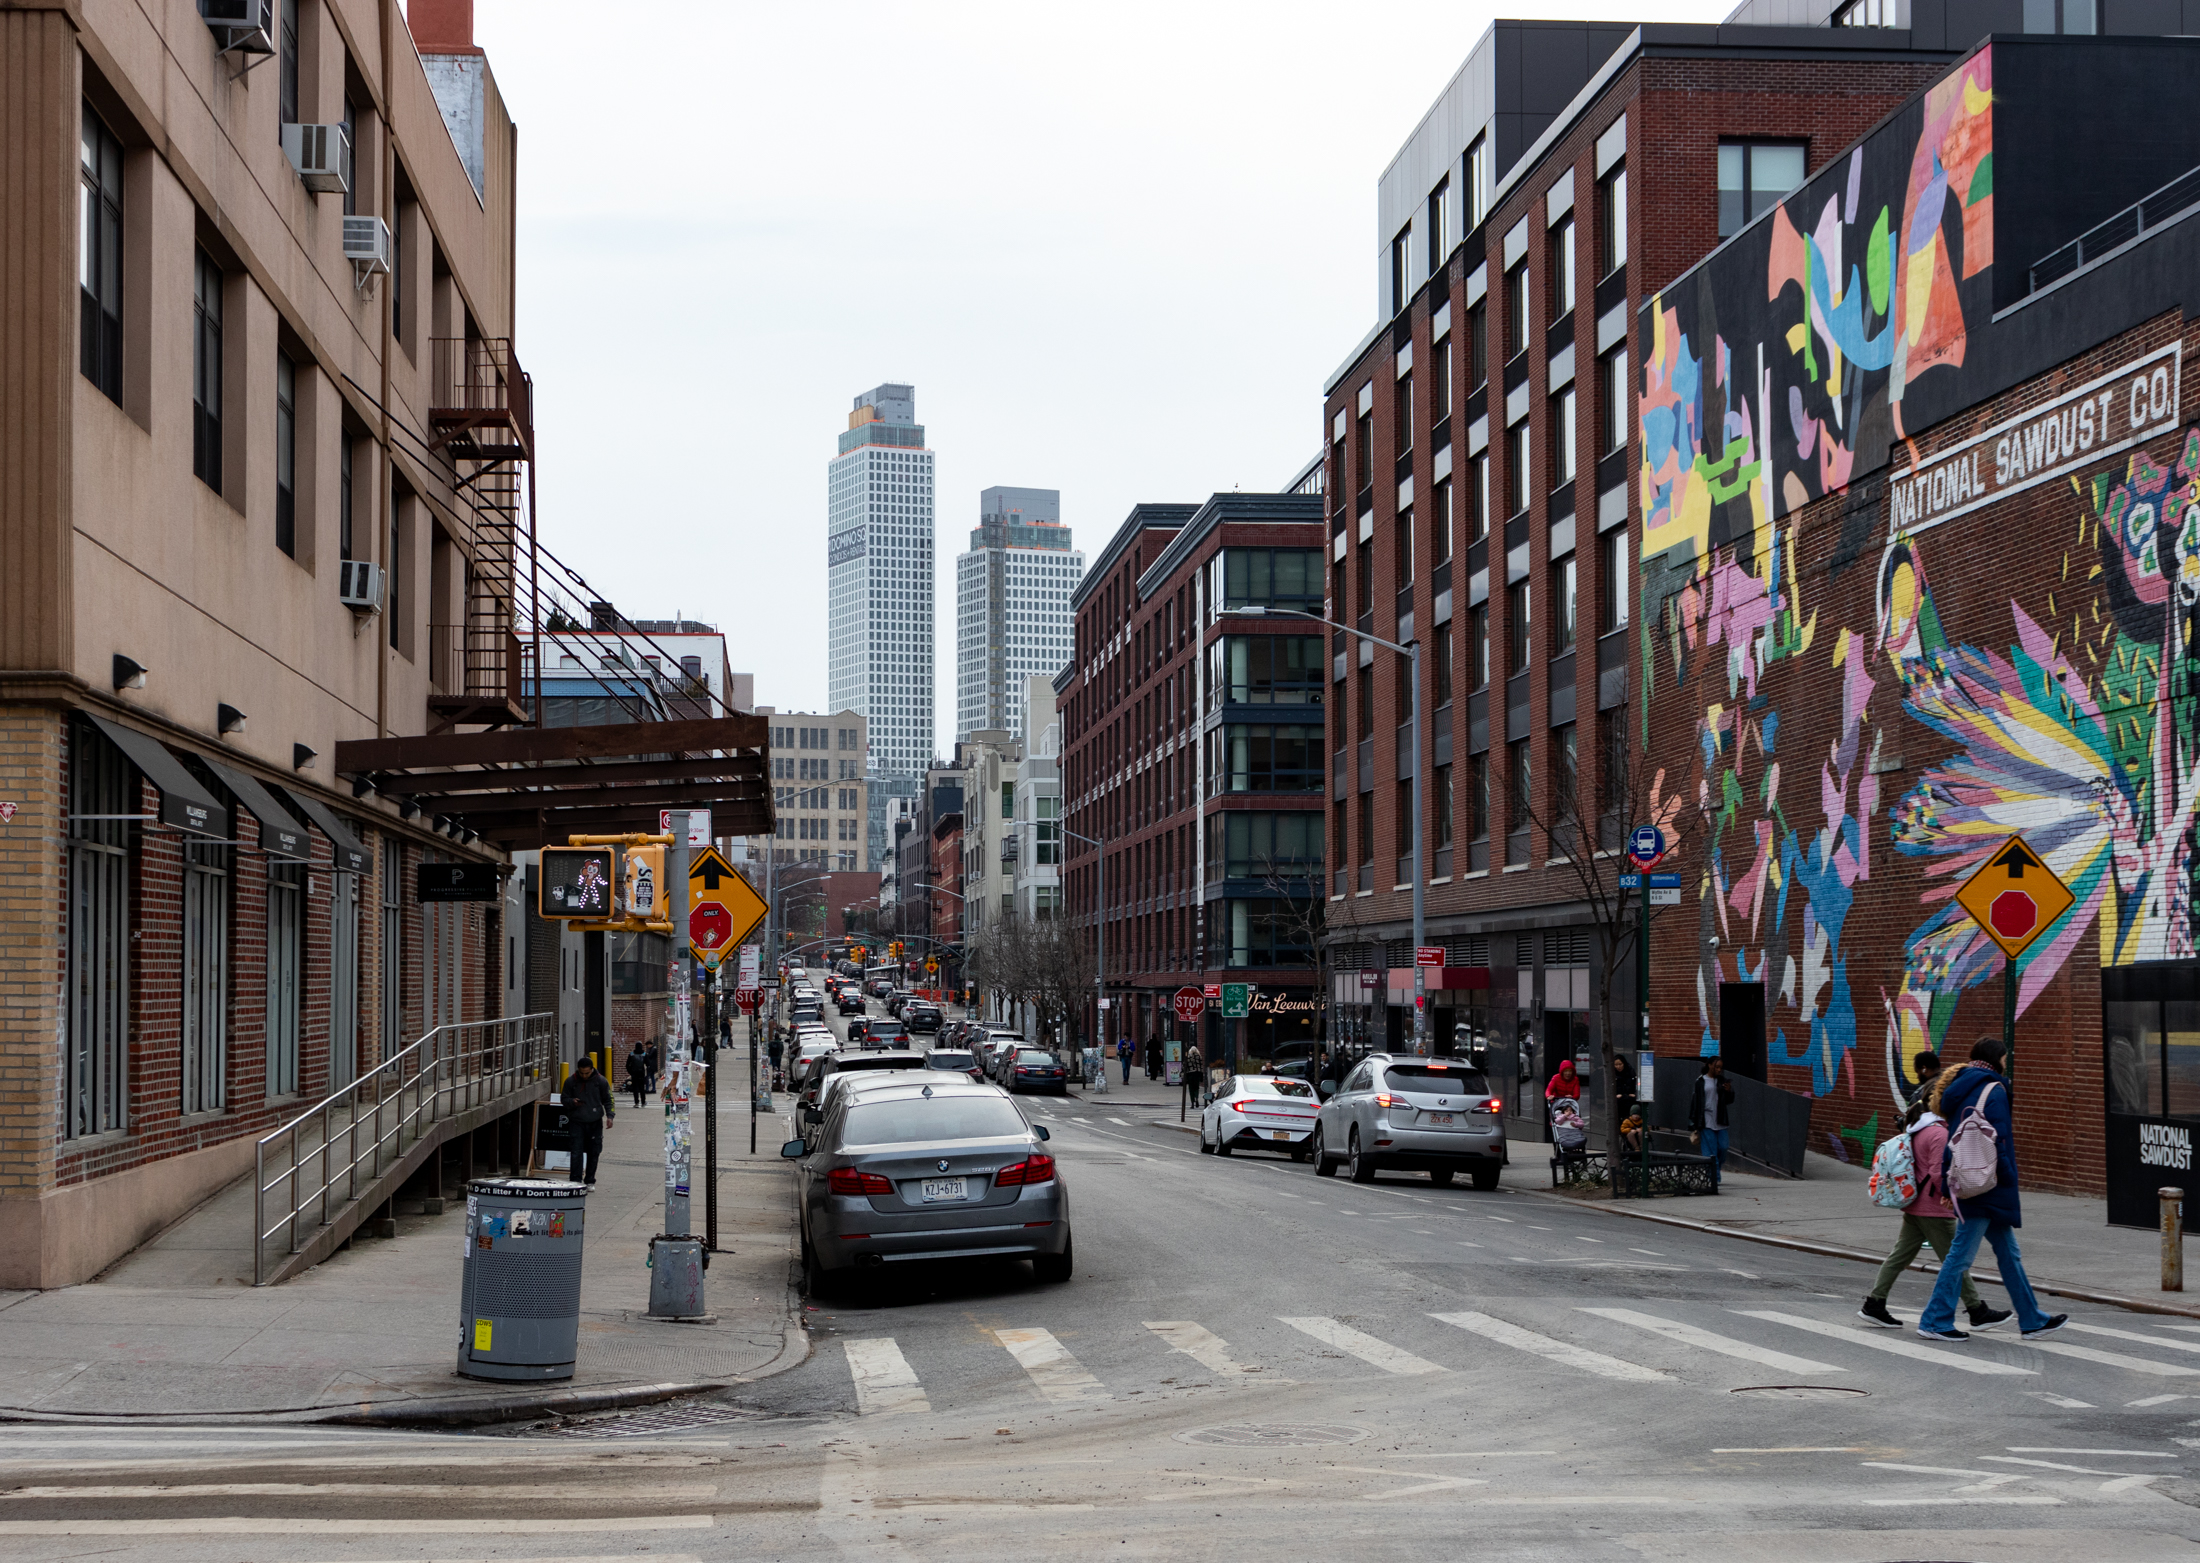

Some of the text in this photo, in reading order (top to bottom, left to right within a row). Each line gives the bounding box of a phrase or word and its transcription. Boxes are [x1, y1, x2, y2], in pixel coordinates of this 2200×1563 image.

[1895, 452, 1986, 526] NATIONAL
[1996, 390, 2113, 485] SAWDUST
[832, 530, 857, 552] DOMINO
[1630, 854, 1662, 867] NO STANDING
[1620, 876, 1637, 886] B32
[1176, 996, 1203, 1008] STOP
[1248, 993, 1272, 1010] Van
[2140, 1123, 2192, 1149] NATIONAL
[2140, 1143, 2192, 1170] SAWDUST
[474, 1185, 491, 1194] Dn't
[493, 1187, 512, 1195] litter
[527, 1189, 550, 1197] Don't
